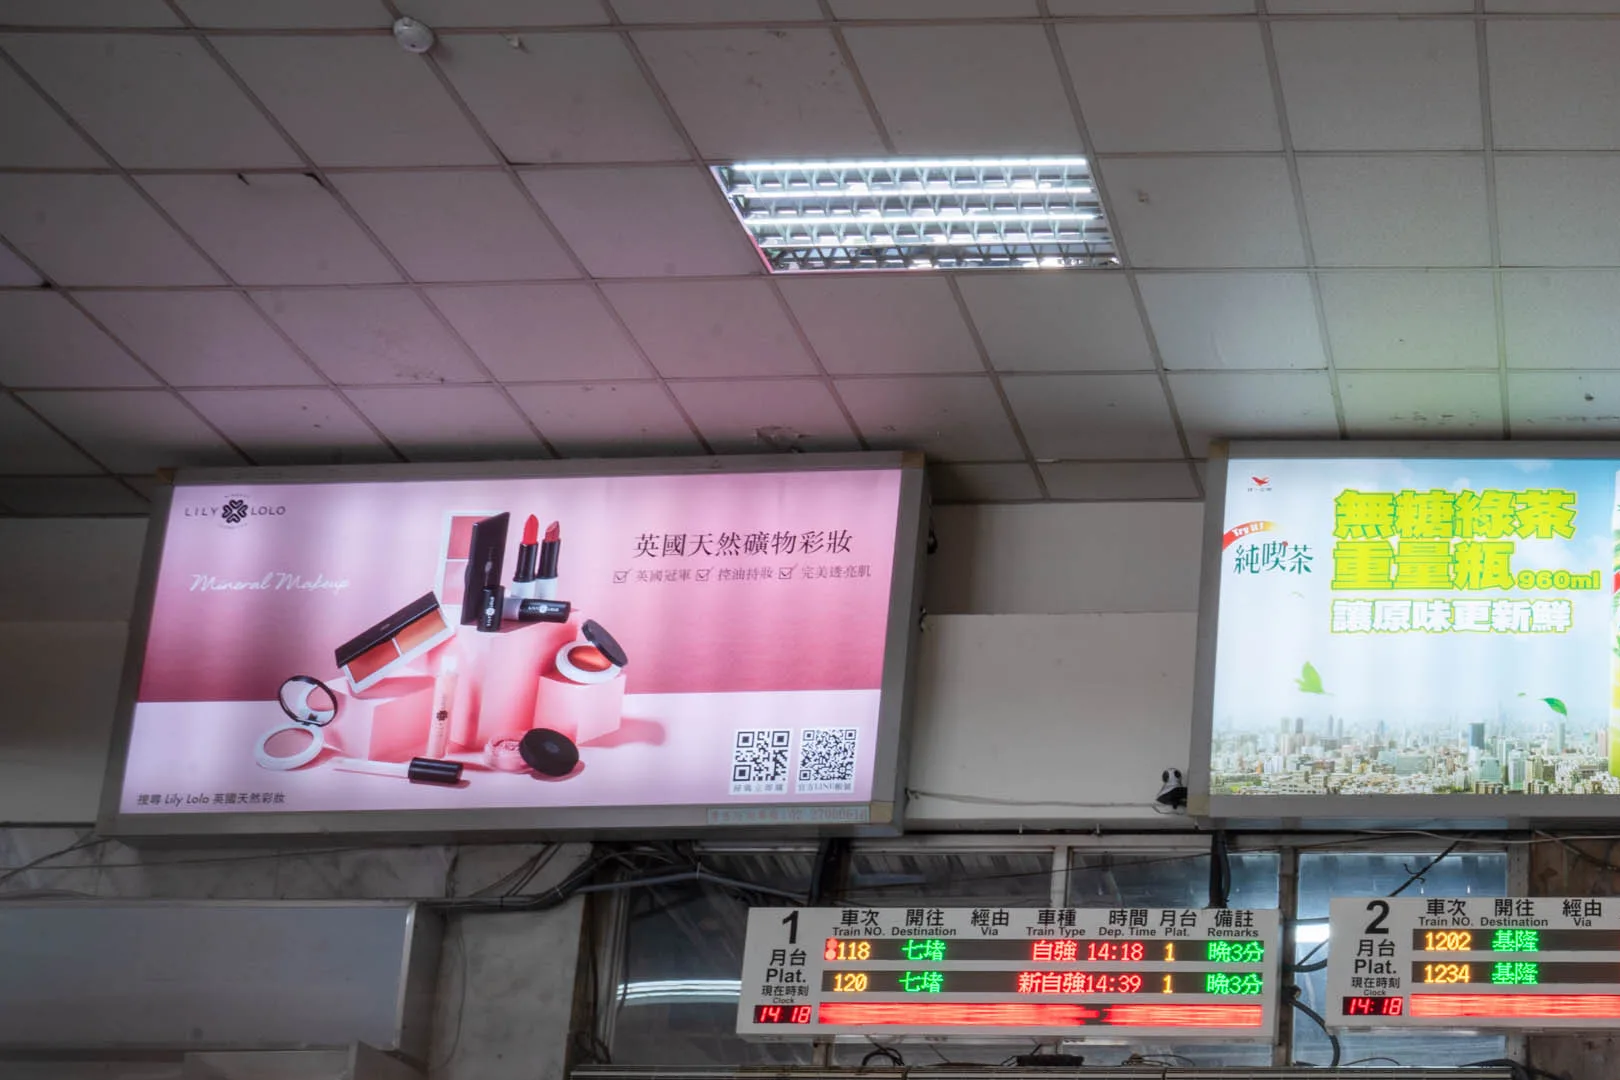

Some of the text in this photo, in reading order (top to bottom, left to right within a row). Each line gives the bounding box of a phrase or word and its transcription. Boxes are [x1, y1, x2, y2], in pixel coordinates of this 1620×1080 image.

[185, 506, 286, 517] LILY LOLO
[1333, 489, 1578, 540] 無糖綠茶
[633, 529, 853, 559] 英國天然礦物彩妝
[1233, 541, 1314, 575] 純喫茶
[1331, 541, 1601, 591] 重量瓶 960ml
[636, 564, 872, 583] 英國冠軍 控油持妝 完美透亮肌
[1331, 599, 1572, 633] 讓原味更新鮮
[1365, 900, 1390, 935] 2
[1426, 899, 1467, 917] 車次
[1494, 899, 1535, 917] 開往
[1562, 899, 1602, 917] 經由
[782, 910, 799, 945] 1
[840, 908, 1254, 928] 車次 開往 經由 車種 時間 月台 備註
[1419, 917, 1448, 927] Train
[1480, 917, 1548, 927] Destination
[1573, 917, 1592, 927] Via
[832, 926, 1259, 939] Train Destination Via Train Type Dep. Time Plat. Remarks
[1424, 931, 1472, 951] 1202
[1492, 929, 1539, 953] 基隆
[769, 949, 808, 967] 月台
[836, 938, 1265, 963] 118 七堵 自強 14:18 1 晚3分
[1356, 939, 1396, 958] 月台
[765, 968, 807, 984] Plat.
[1354, 959, 1397, 975] Plat.
[1423, 963, 1471, 983] 1234
[1491, 961, 1539, 985] 基隆
[761, 985, 809, 997] 現在時刻
[833, 971, 1264, 995] 120 七堵 新自強 14:39 1 晚3分
[1350, 977, 1401, 989] 現在時刻
[1350, 997, 1402, 1015] 14:18
